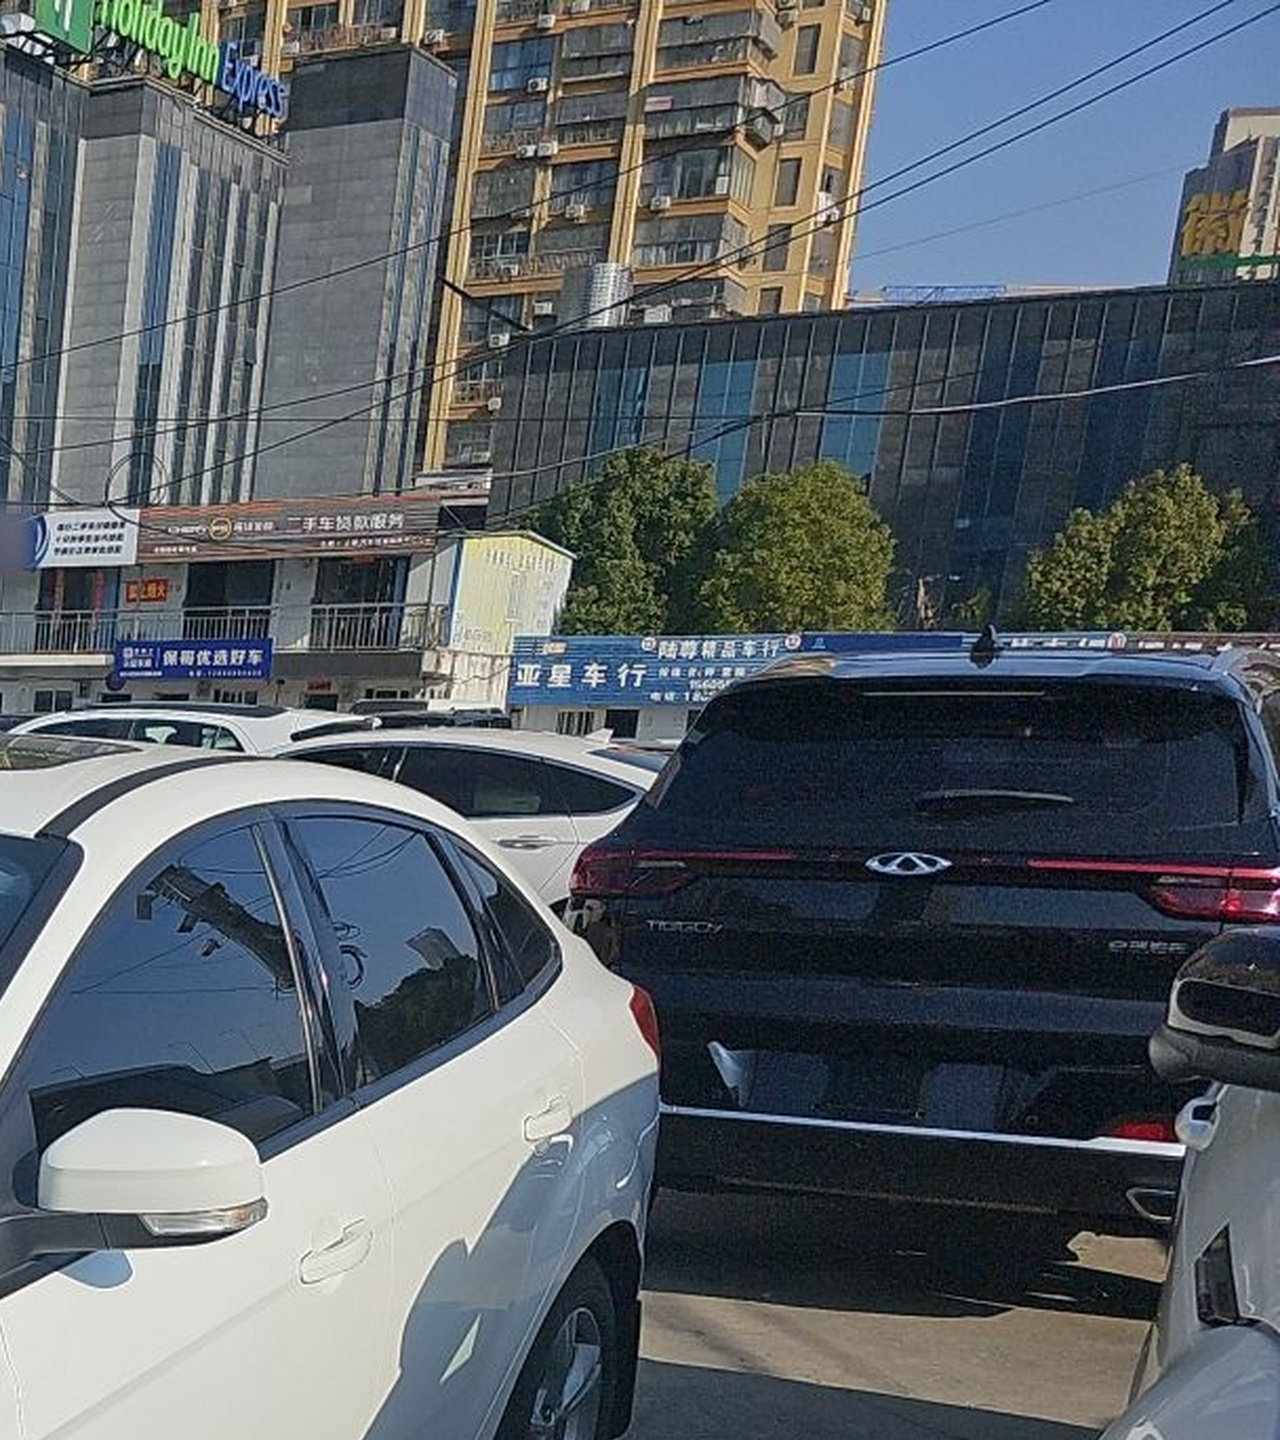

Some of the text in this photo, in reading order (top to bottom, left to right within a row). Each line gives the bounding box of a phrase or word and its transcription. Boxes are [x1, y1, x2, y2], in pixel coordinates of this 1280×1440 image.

[221, 42, 288, 118] Express
[287, 513, 405, 534] 二手车贷款服务
[515, 662, 647, 688] 亚星车行
